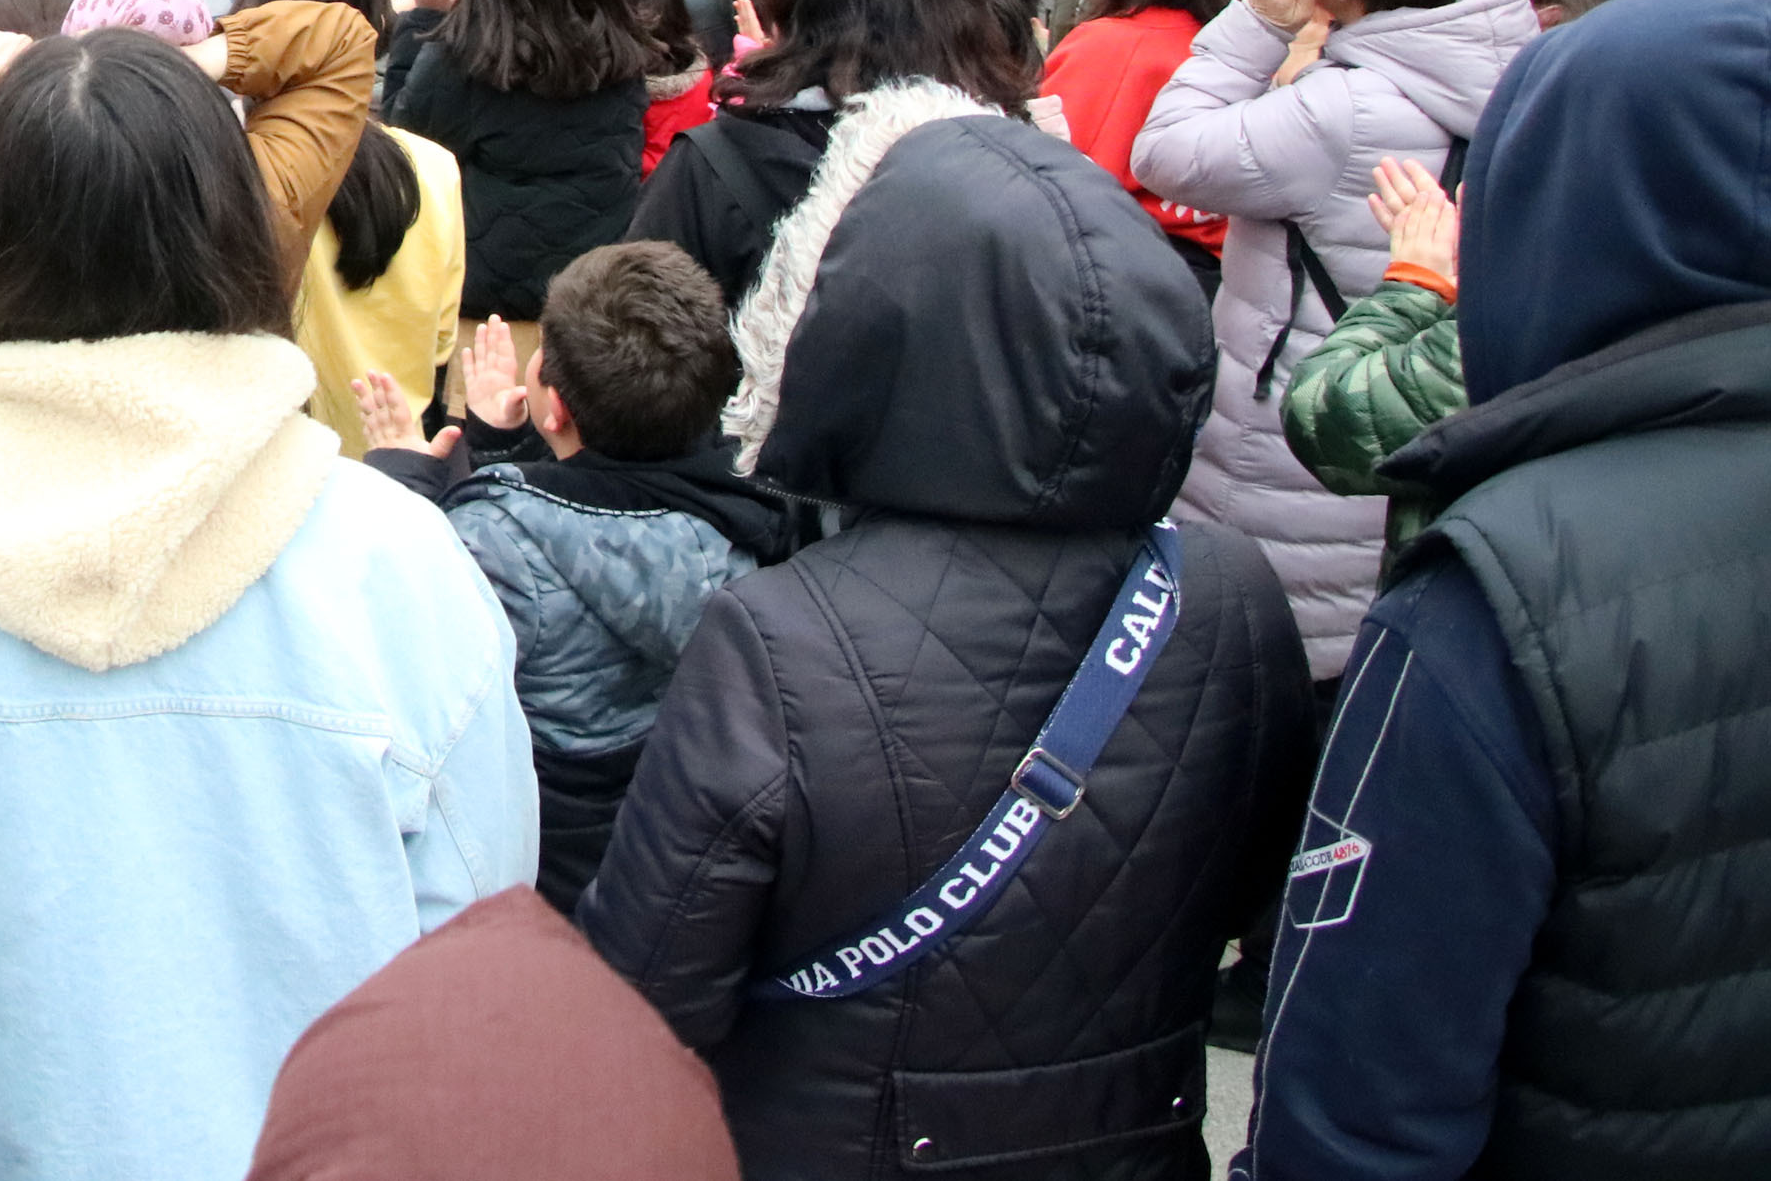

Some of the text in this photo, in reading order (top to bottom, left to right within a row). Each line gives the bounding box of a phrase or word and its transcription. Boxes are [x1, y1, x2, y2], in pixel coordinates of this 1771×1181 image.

[835, 906, 945, 979] POLO
[938, 796, 1041, 909] CLUB
[1305, 850, 1334, 868] CODE
